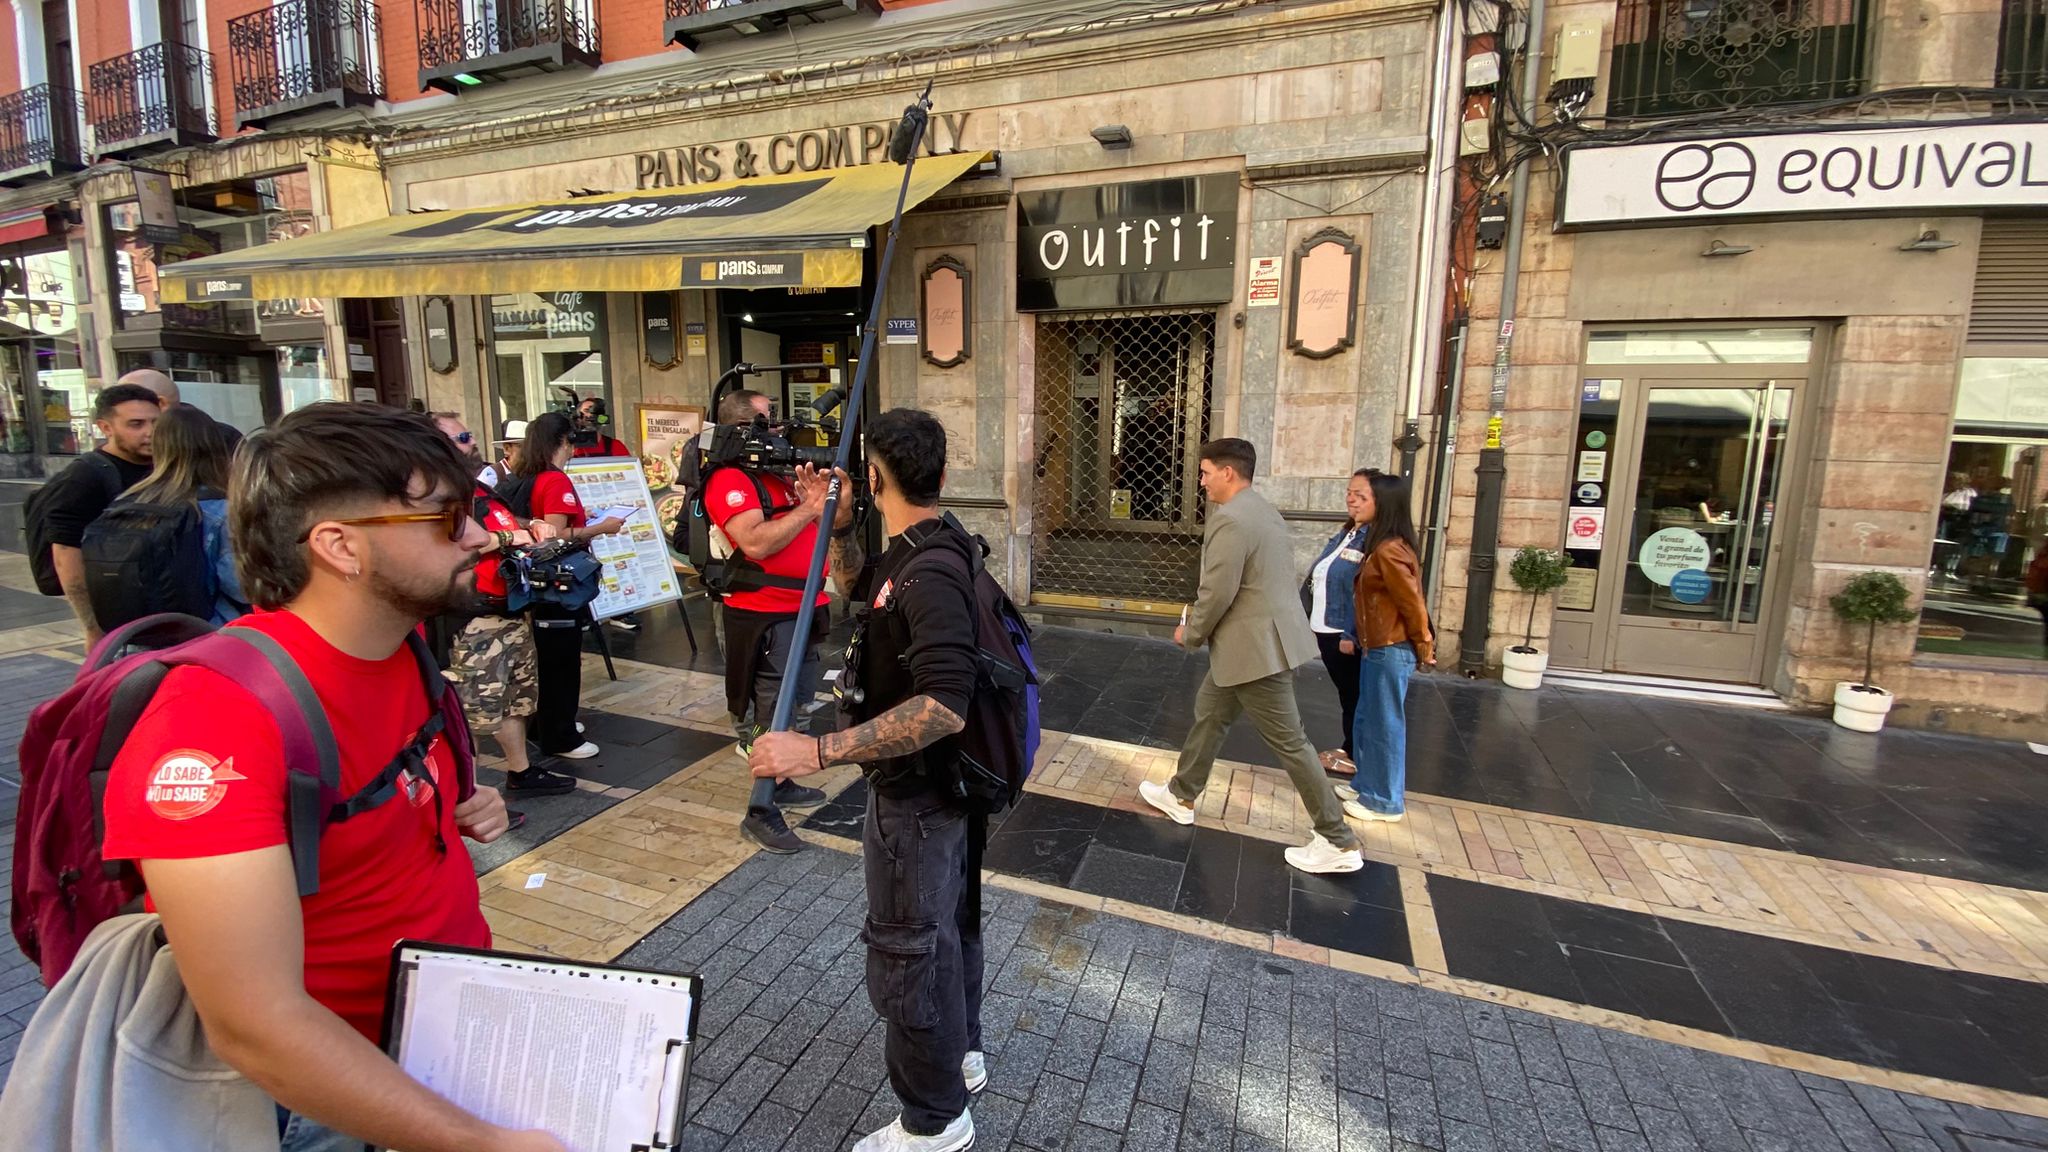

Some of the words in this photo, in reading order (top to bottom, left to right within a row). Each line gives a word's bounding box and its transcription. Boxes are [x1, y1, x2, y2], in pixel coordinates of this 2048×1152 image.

[635, 145, 722, 190] PANS
[734, 140, 759, 179] &
[515, 203, 658, 227] pans
[719, 260, 757, 280] pans
[761, 264, 784, 275] COMPANY
[206, 280, 227, 296] pans
[545, 311, 595, 339] pans
[648, 318, 669, 330] pans
[888, 319, 916, 329] SYPER
[647, 425, 661, 433] ESTA
[662, 426, 690, 434] ENSALADA
[1659, 535, 1685, 543] Venta
[1654, 560, 1690, 568] favorito
[1666, 554, 1704, 562] perfume
[158, 766, 171, 781] LO
[174, 766, 206, 781] SABE
[173, 786, 208, 802] SABE
